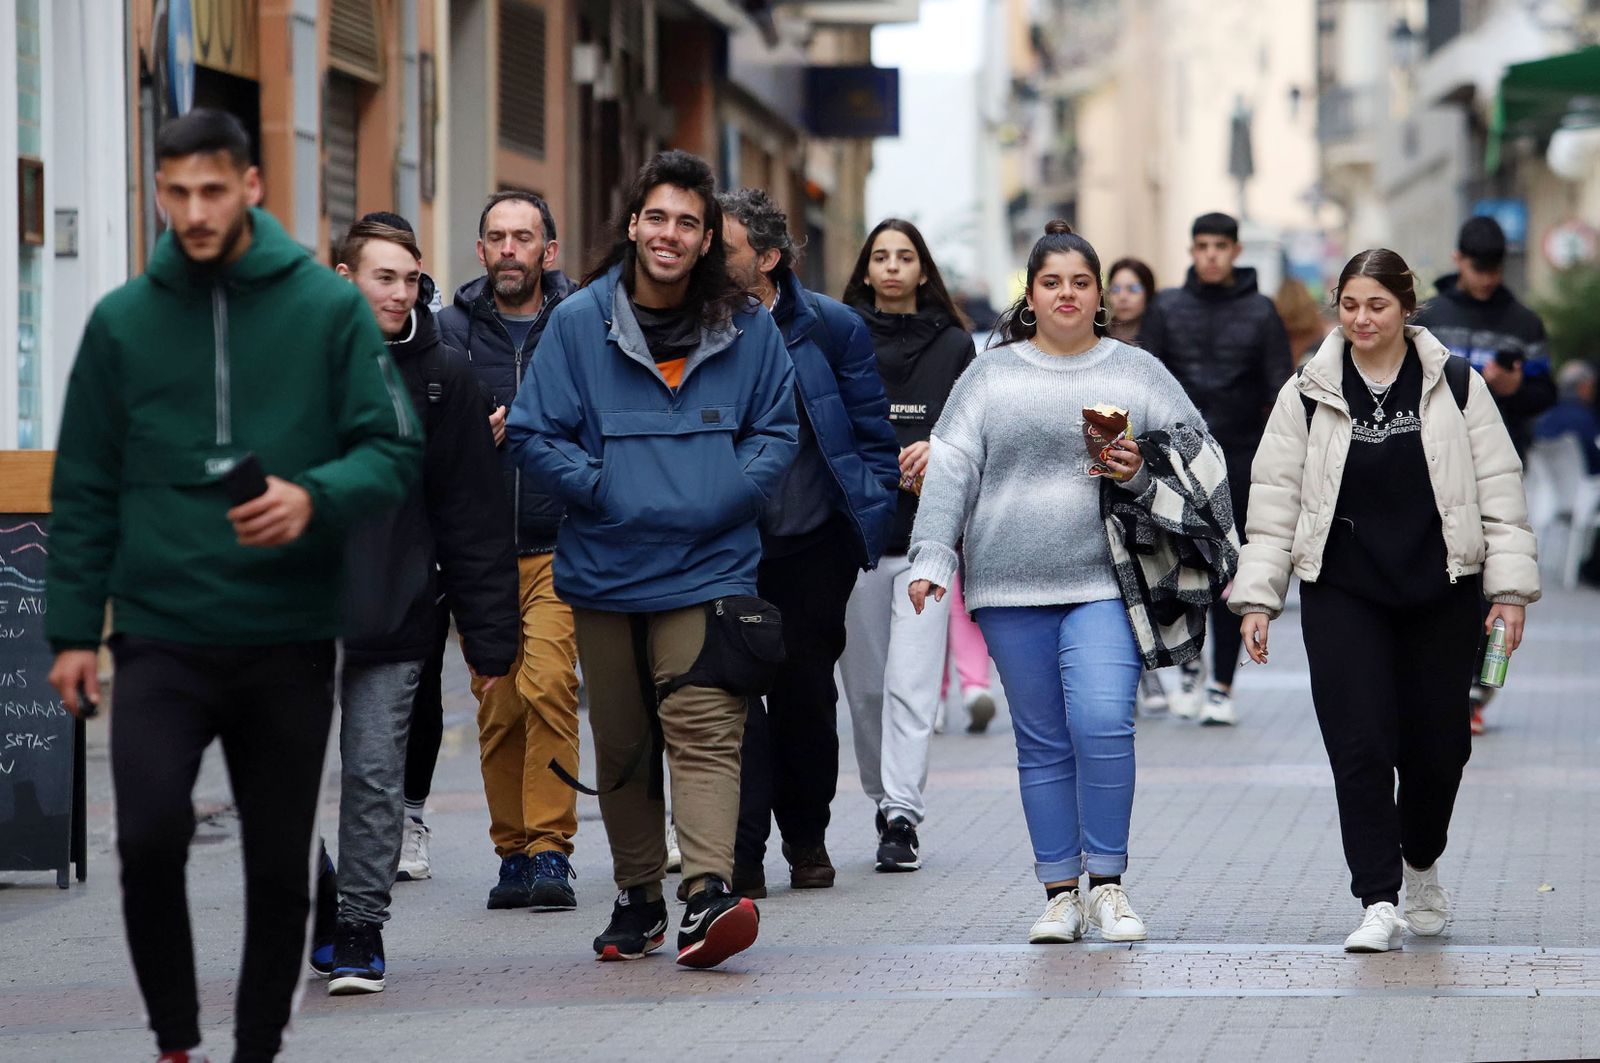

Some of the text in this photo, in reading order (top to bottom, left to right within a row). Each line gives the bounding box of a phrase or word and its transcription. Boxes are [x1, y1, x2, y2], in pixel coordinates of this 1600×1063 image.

[890, 404, 927, 413] REPUBLIC
[0, 699, 67, 719] RDURAS
[4, 732, 58, 751] SETAS
